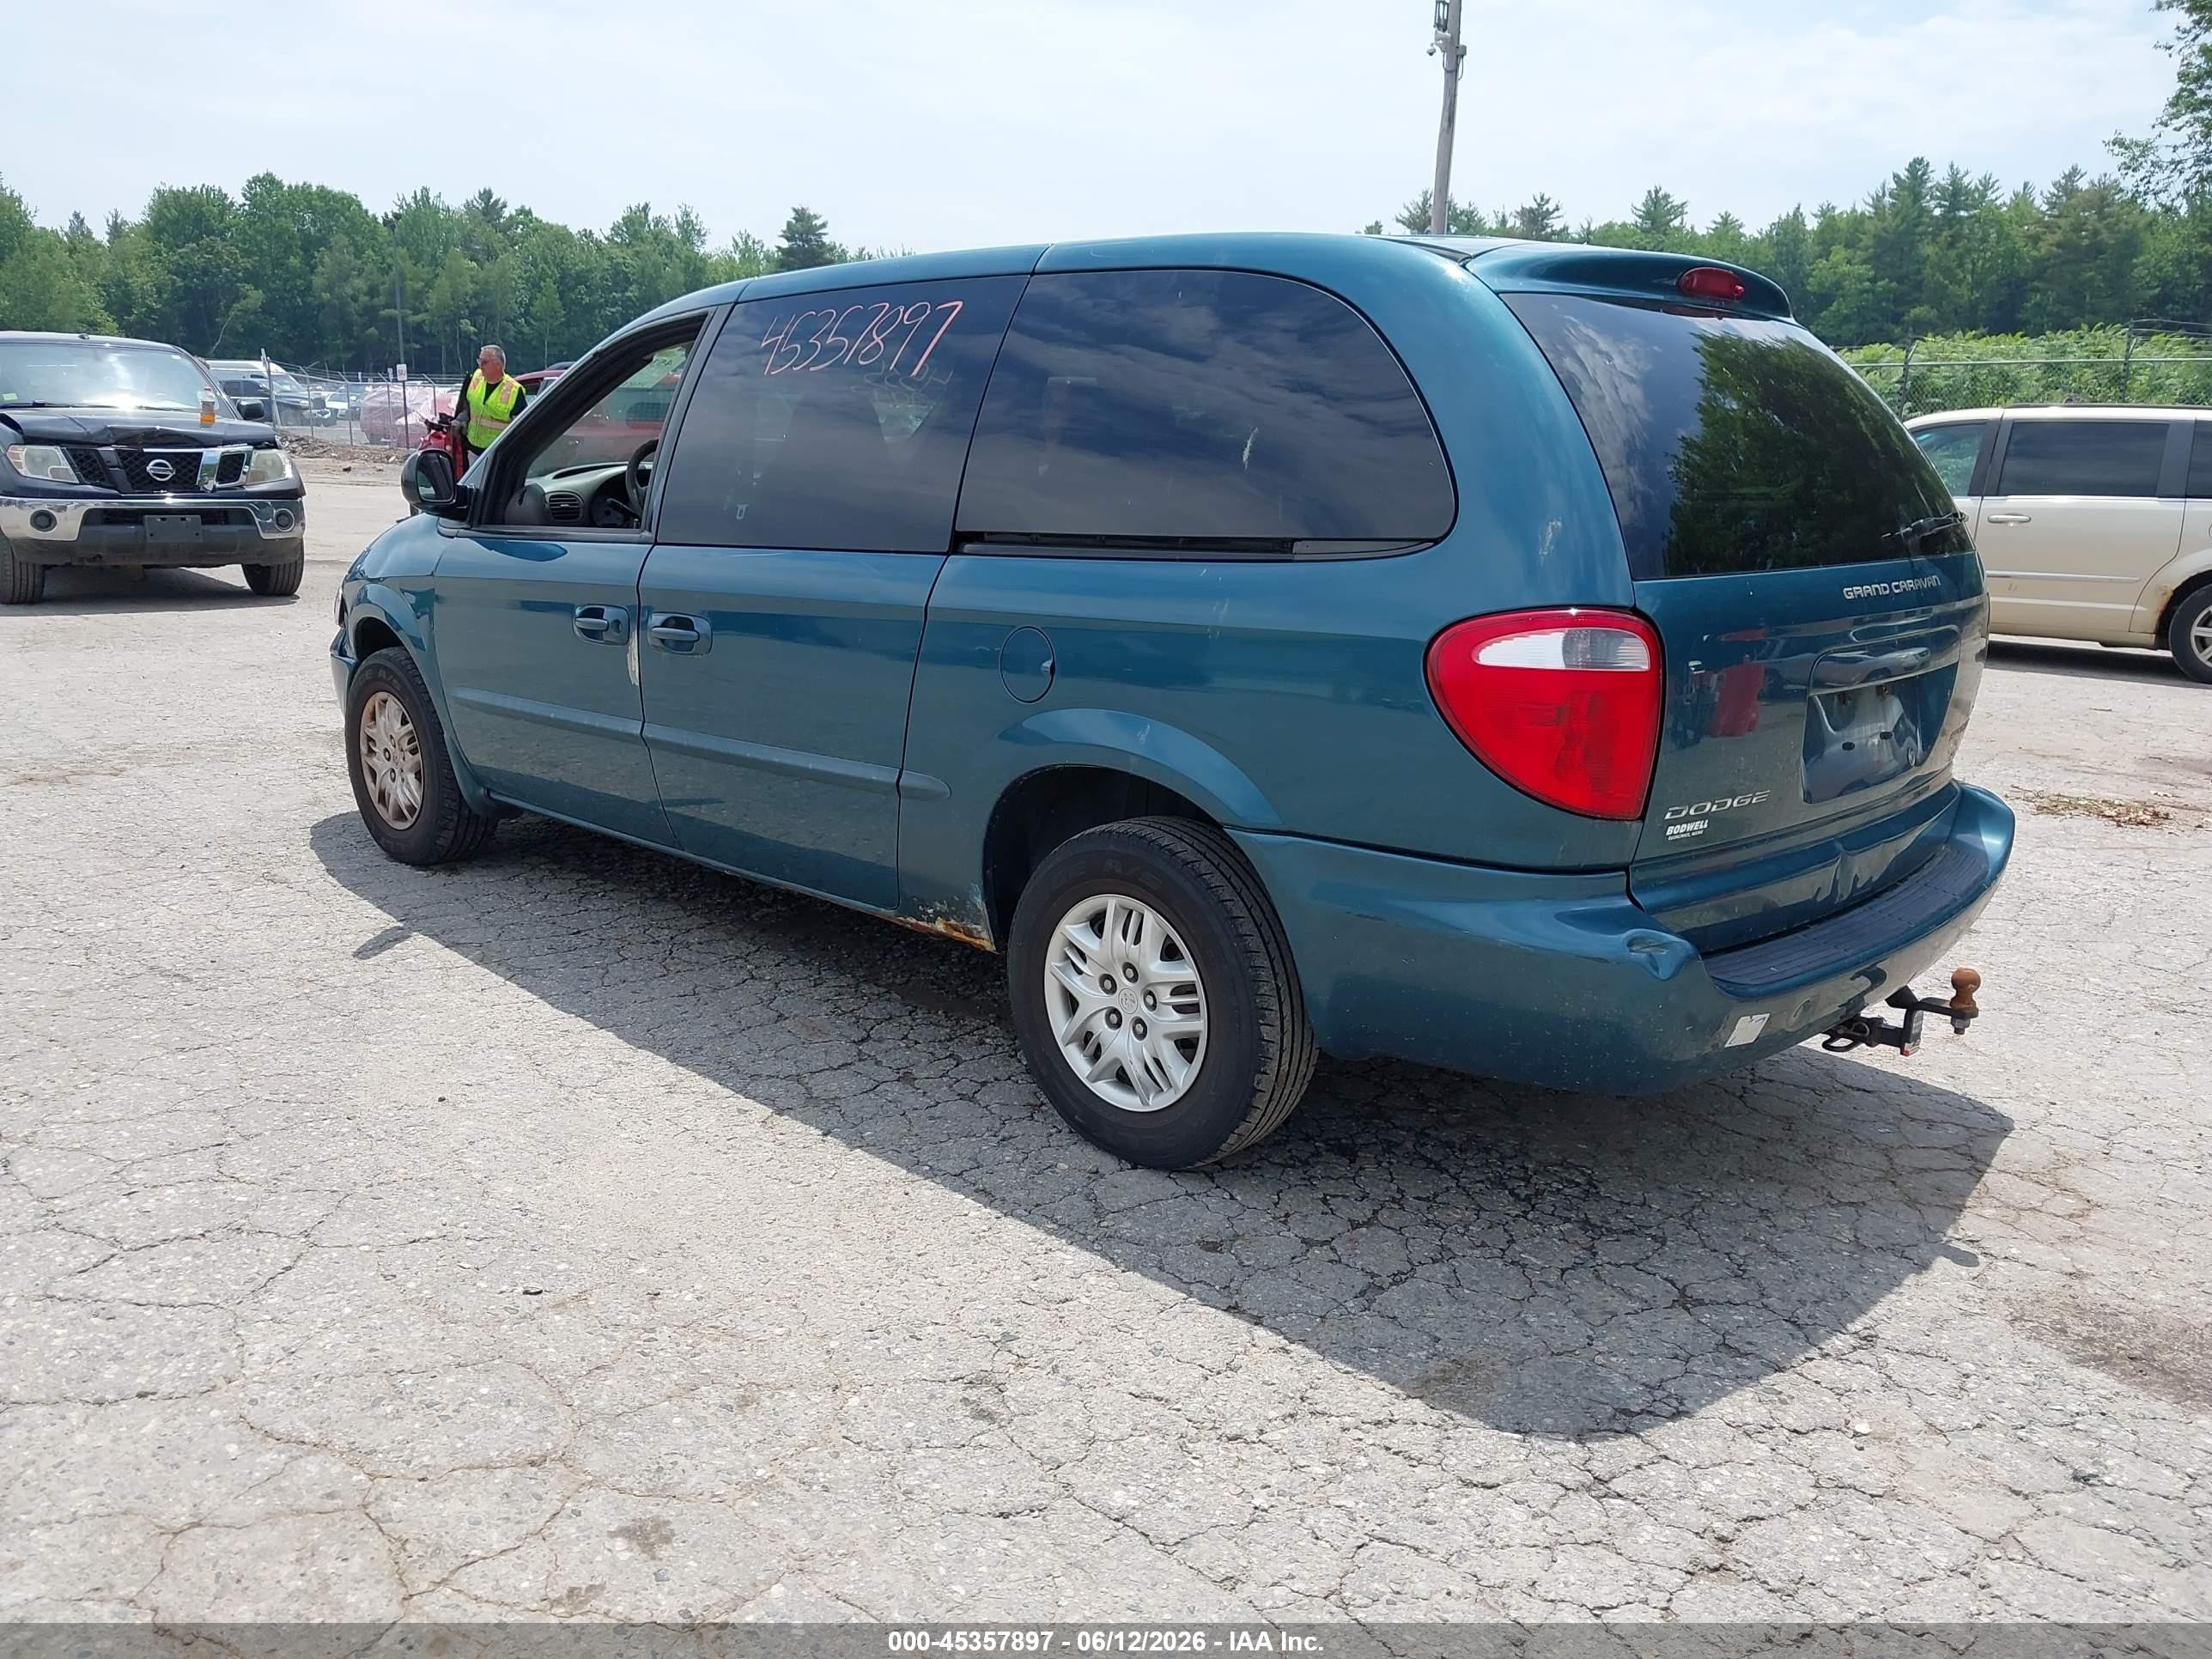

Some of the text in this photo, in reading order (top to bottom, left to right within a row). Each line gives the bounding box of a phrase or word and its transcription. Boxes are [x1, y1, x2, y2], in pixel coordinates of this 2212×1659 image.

[761, 301, 963, 377] 45357897
[1843, 574, 1942, 600] GRAND CARAVAN
[1664, 789, 1771, 820] DODGE
[1666, 818, 1709, 836] BODWELL
